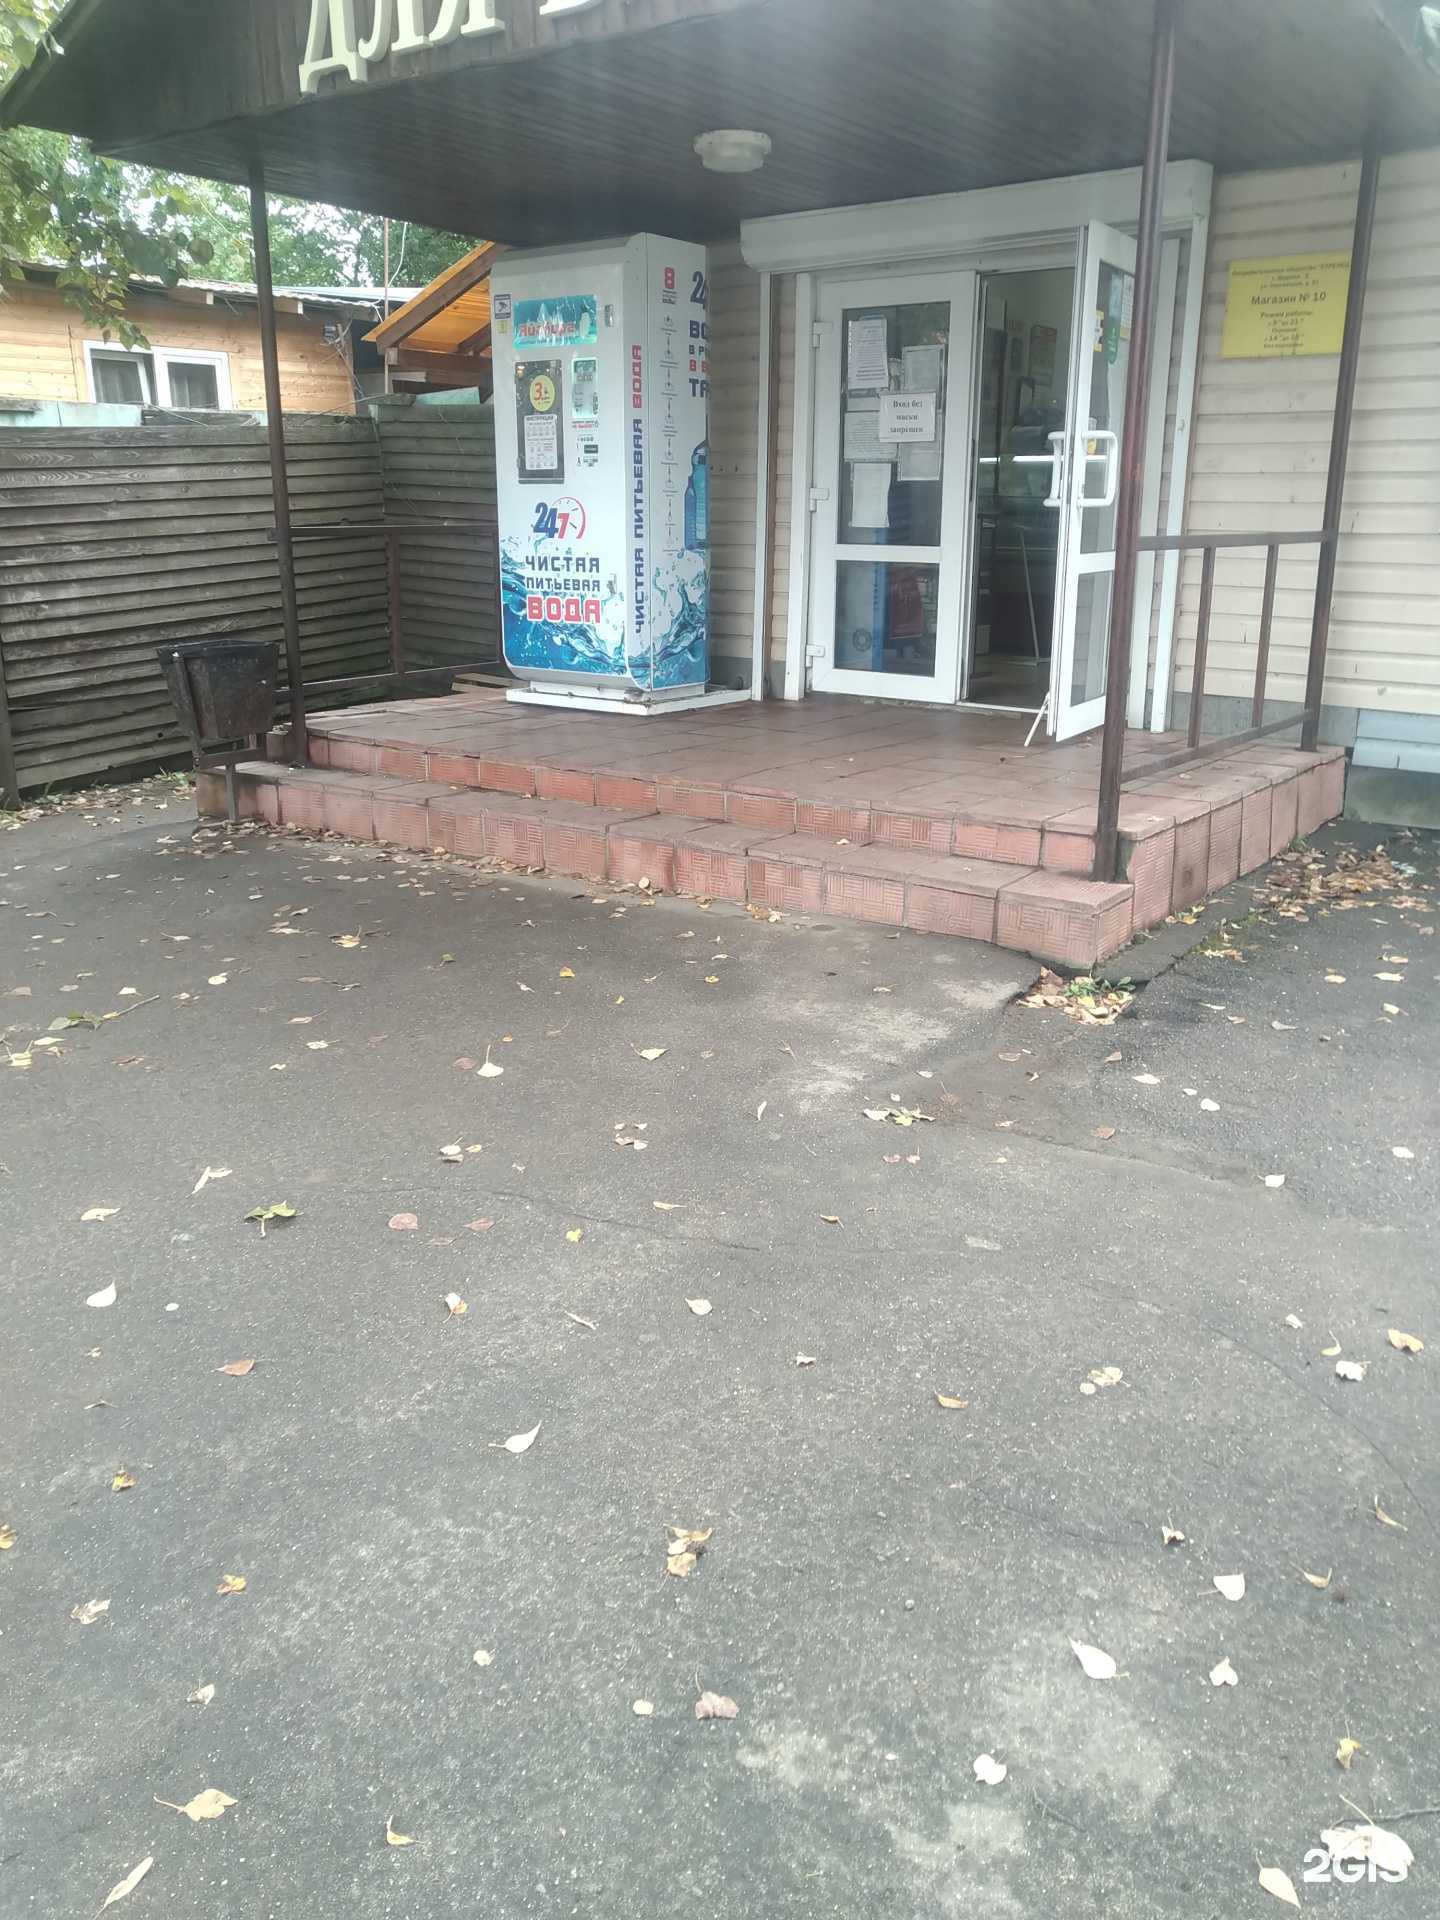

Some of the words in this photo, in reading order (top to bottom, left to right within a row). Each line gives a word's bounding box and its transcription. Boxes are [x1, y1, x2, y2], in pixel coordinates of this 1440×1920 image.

[1251, 295, 1297, 305] Магазин
[1314, 291, 1327, 302] 10
[632, 344, 642, 408] ВОДА
[633, 418, 644, 538] ПИТЬЕВАЯ
[525, 555, 600, 573] ЧИСТАЯ
[526, 577, 600, 592] ПИТЬЕВАЯ
[634, 547, 645, 633] ЧИСТАЯ
[527, 596, 601, 623] ВОДА
